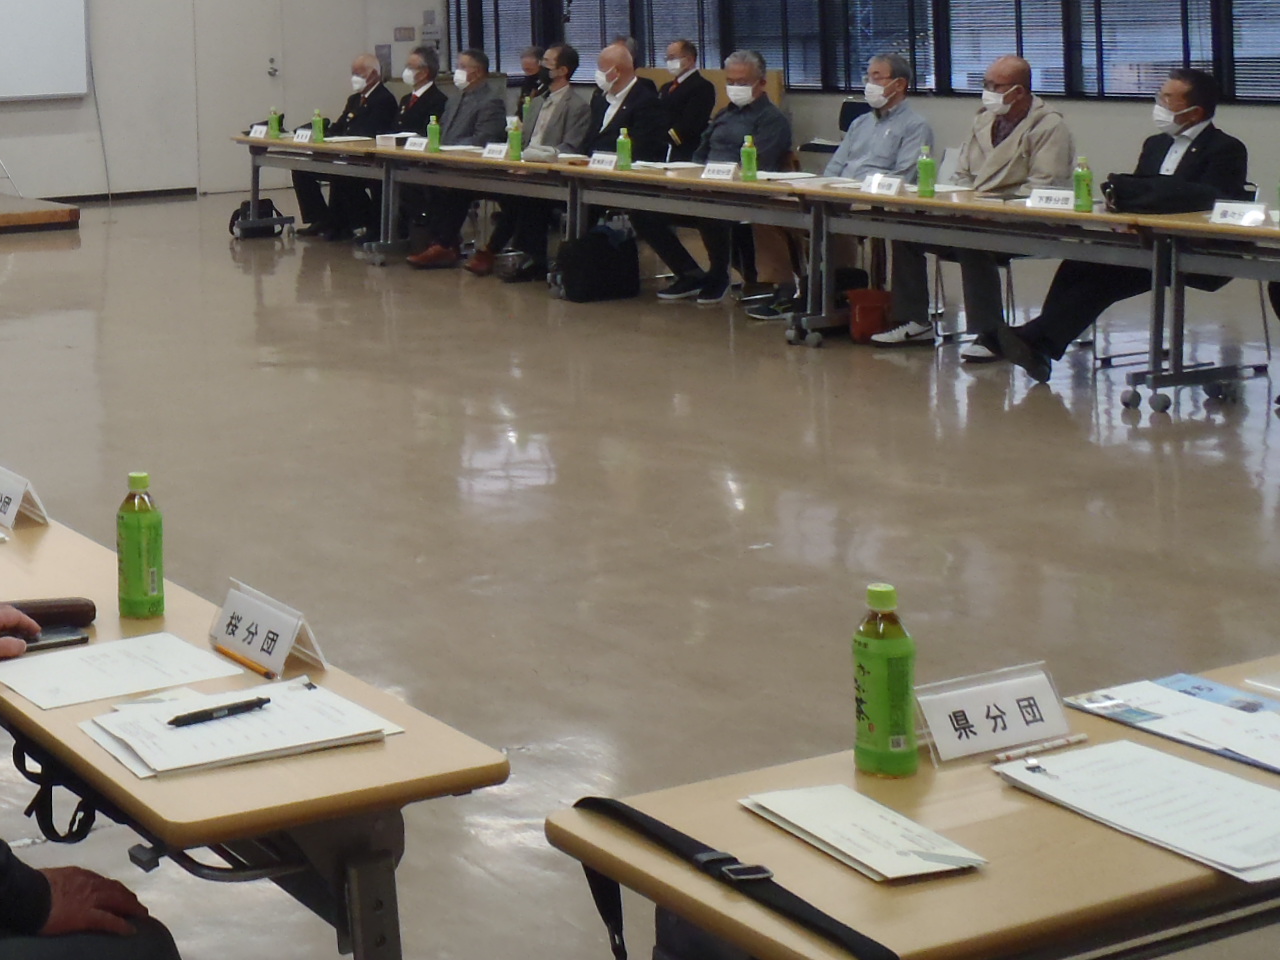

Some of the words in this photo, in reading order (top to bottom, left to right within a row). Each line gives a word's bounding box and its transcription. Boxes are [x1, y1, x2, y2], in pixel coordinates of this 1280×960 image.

[225, 611, 280, 656] 桜分団
[948, 696, 1045, 740] 県分団
